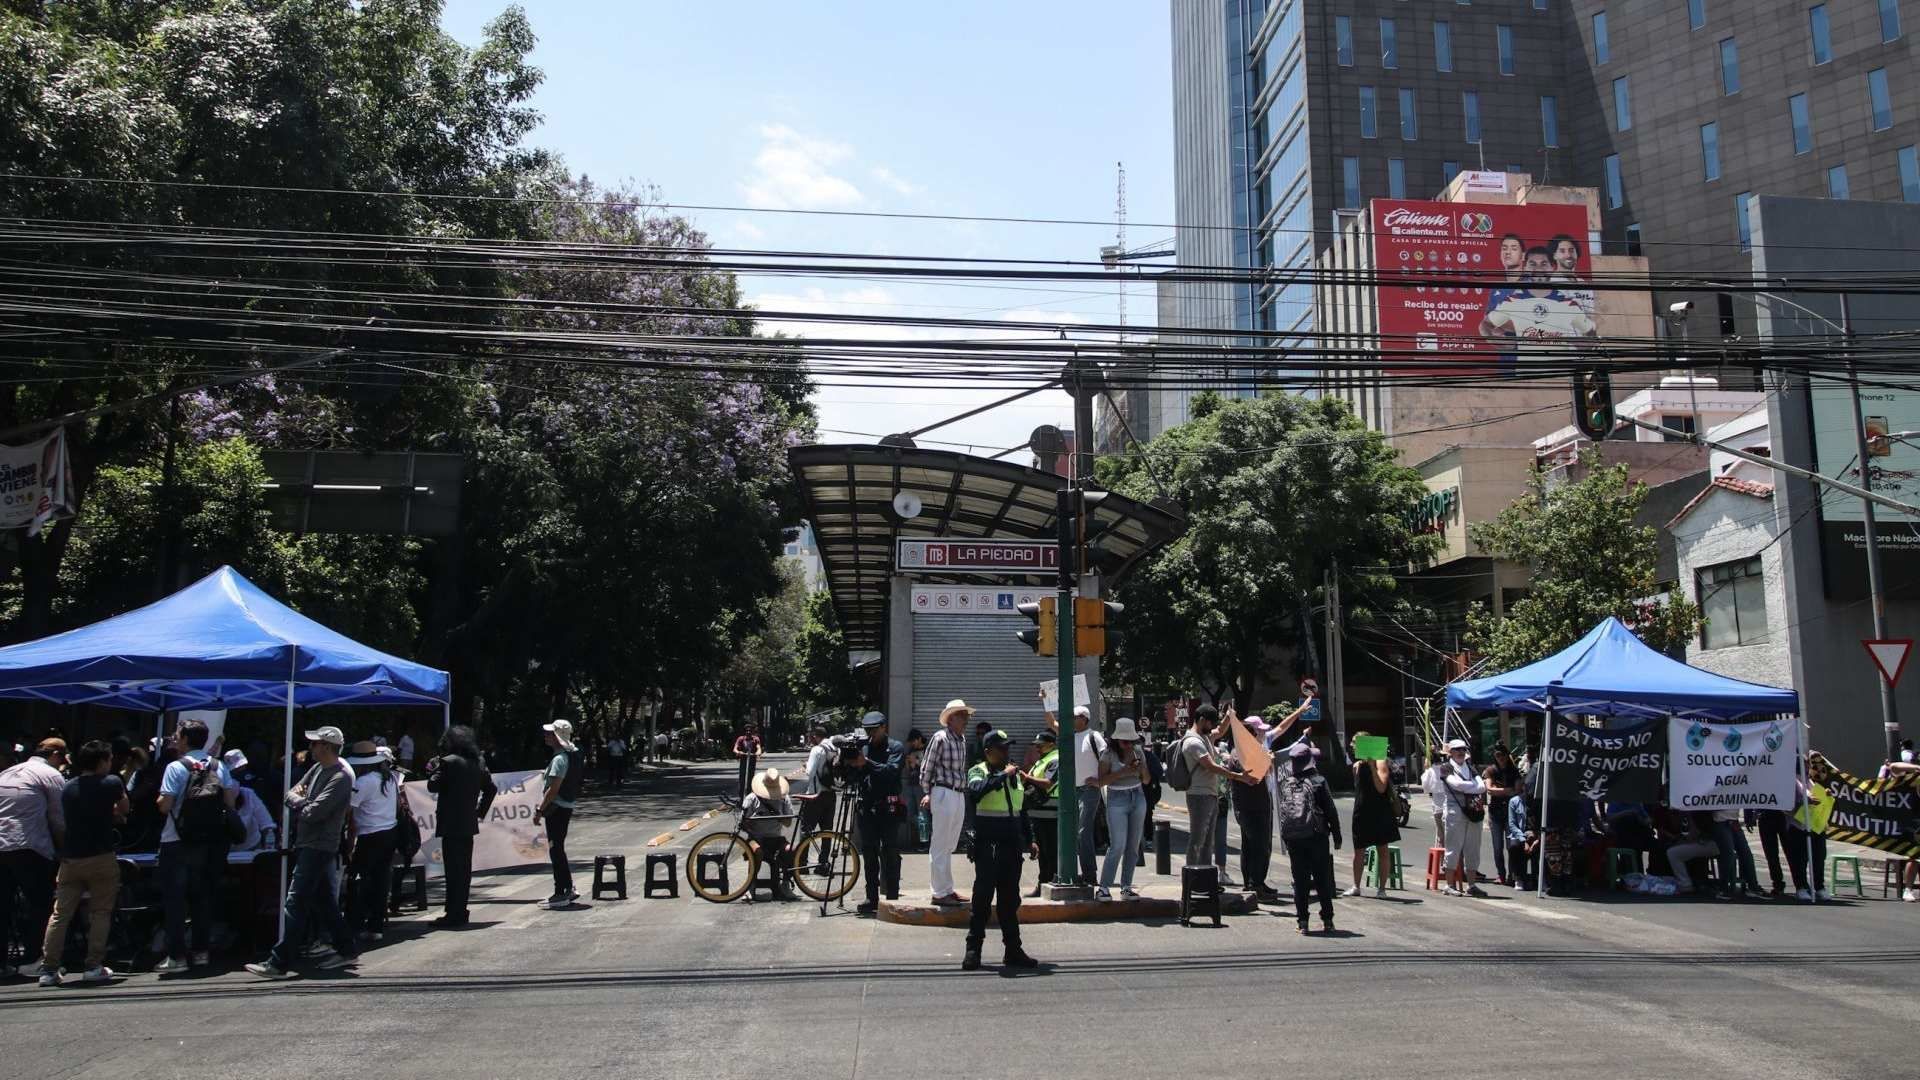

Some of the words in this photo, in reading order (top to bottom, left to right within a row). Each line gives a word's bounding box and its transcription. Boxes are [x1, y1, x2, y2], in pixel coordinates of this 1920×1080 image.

[1384, 208, 1449, 227] Caliente
[1401, 227, 1448, 236] caliente.mx
[1404, 301, 1435, 309] Recibe
[1424, 310, 1464, 322] $1,000
[957, 549, 976, 560] LA
[980, 549, 1034, 561] PIEDAD
[1048, 551, 1055, 565] 1
[1556, 724, 1624, 750] BATRES
[1628, 732, 1652, 748] NO
[1581, 754, 1660, 771] IGNORES
[1687, 753, 1757, 767] SOLUCIÓN
[1758, 754, 1775, 766] AL
[1715, 774, 1749, 787] AGUA
[1682, 793, 1778, 807] CONTAMINADA
[1830, 781, 1911, 809] SACMEX
[1831, 811, 1903, 836] INÚTIL
